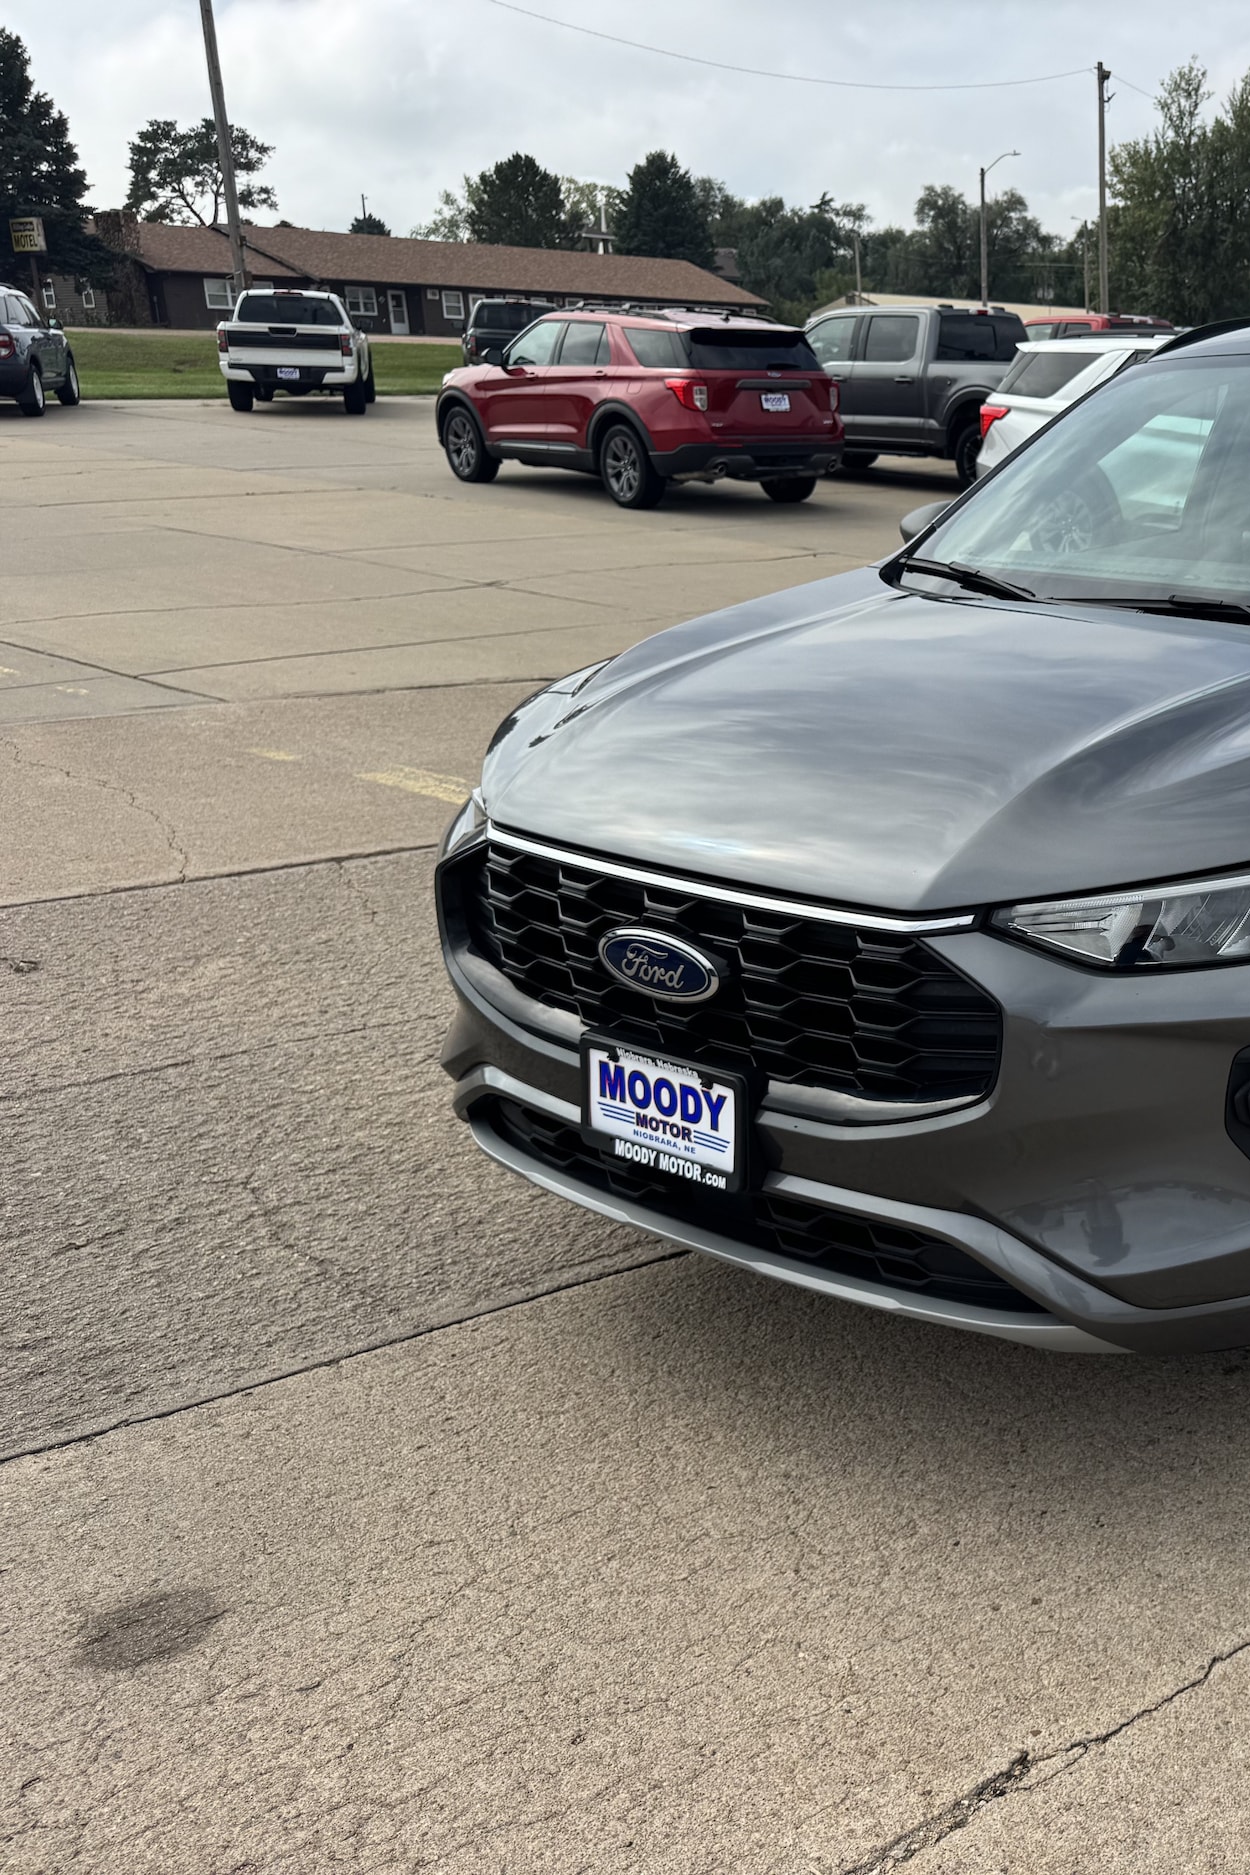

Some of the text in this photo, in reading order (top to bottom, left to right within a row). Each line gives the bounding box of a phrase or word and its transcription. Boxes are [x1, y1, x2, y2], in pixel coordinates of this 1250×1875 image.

[13, 233, 38, 249] MOTEL
[621, 943, 684, 989] Ford
[598, 1060, 728, 1132] MOODY
[633, 1128, 697, 1155] NIOBRARA, NE
[635, 1112, 694, 1143] MOTOR
[615, 1138, 658, 1167] MOODY
